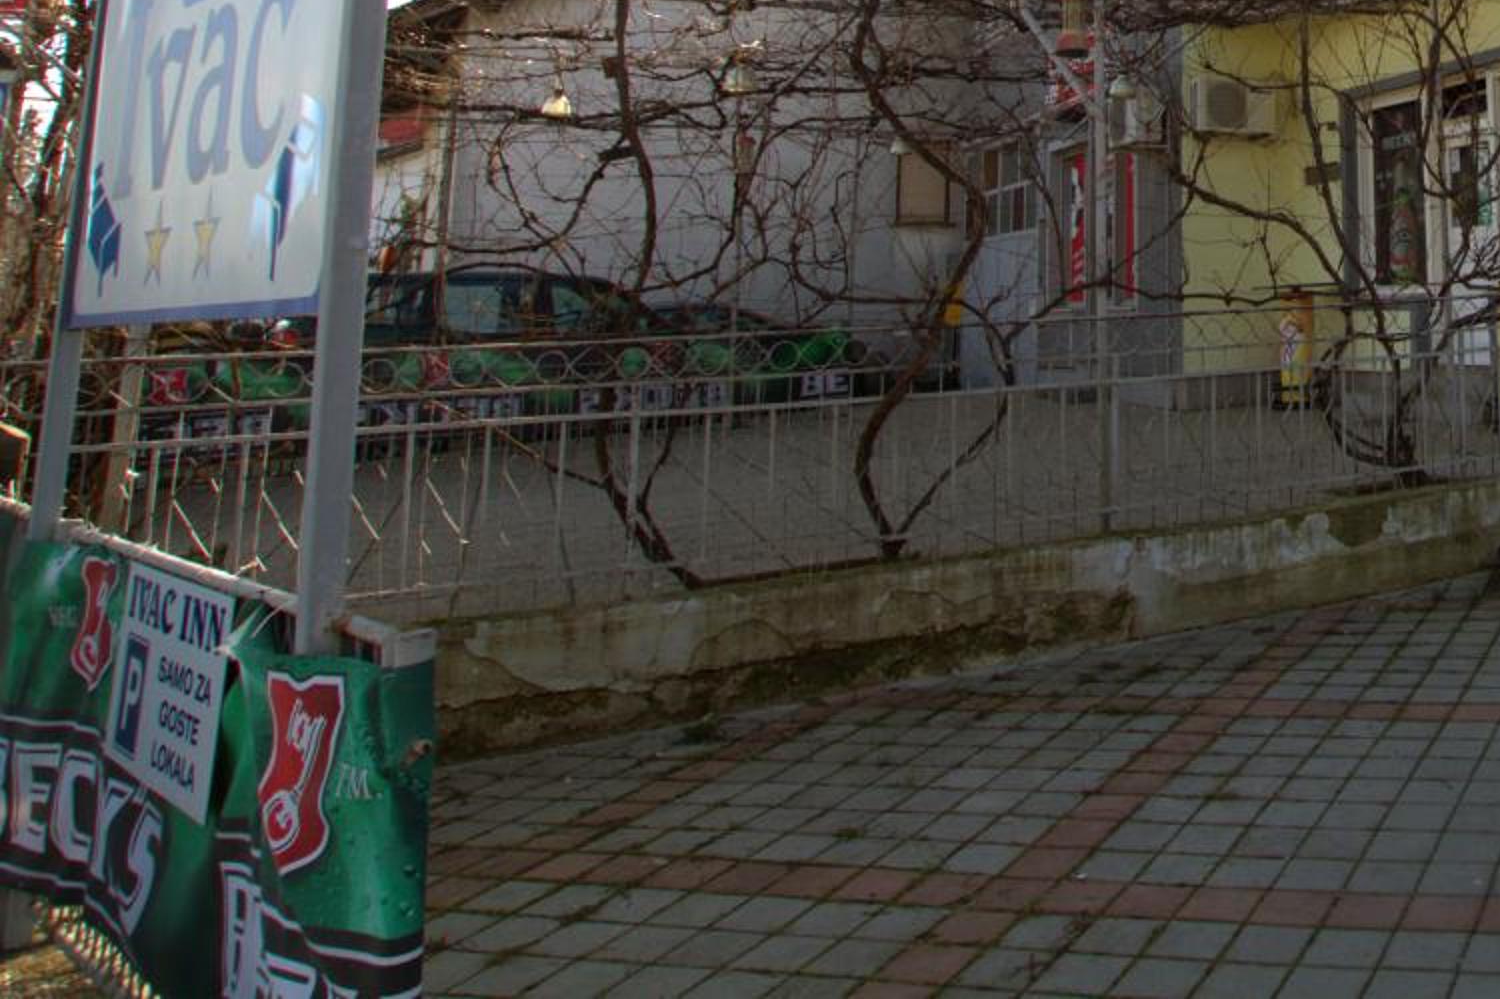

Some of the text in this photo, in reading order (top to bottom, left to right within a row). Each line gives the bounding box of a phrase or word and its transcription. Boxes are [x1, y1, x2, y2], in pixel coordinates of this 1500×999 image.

[129, 575, 176, 634] IVAC
[180, 594, 227, 656] INN
[158, 655, 212, 707] SAMO ZA
[160, 699, 201, 746] GOSTE
[151, 739, 195, 794] LOKALA
